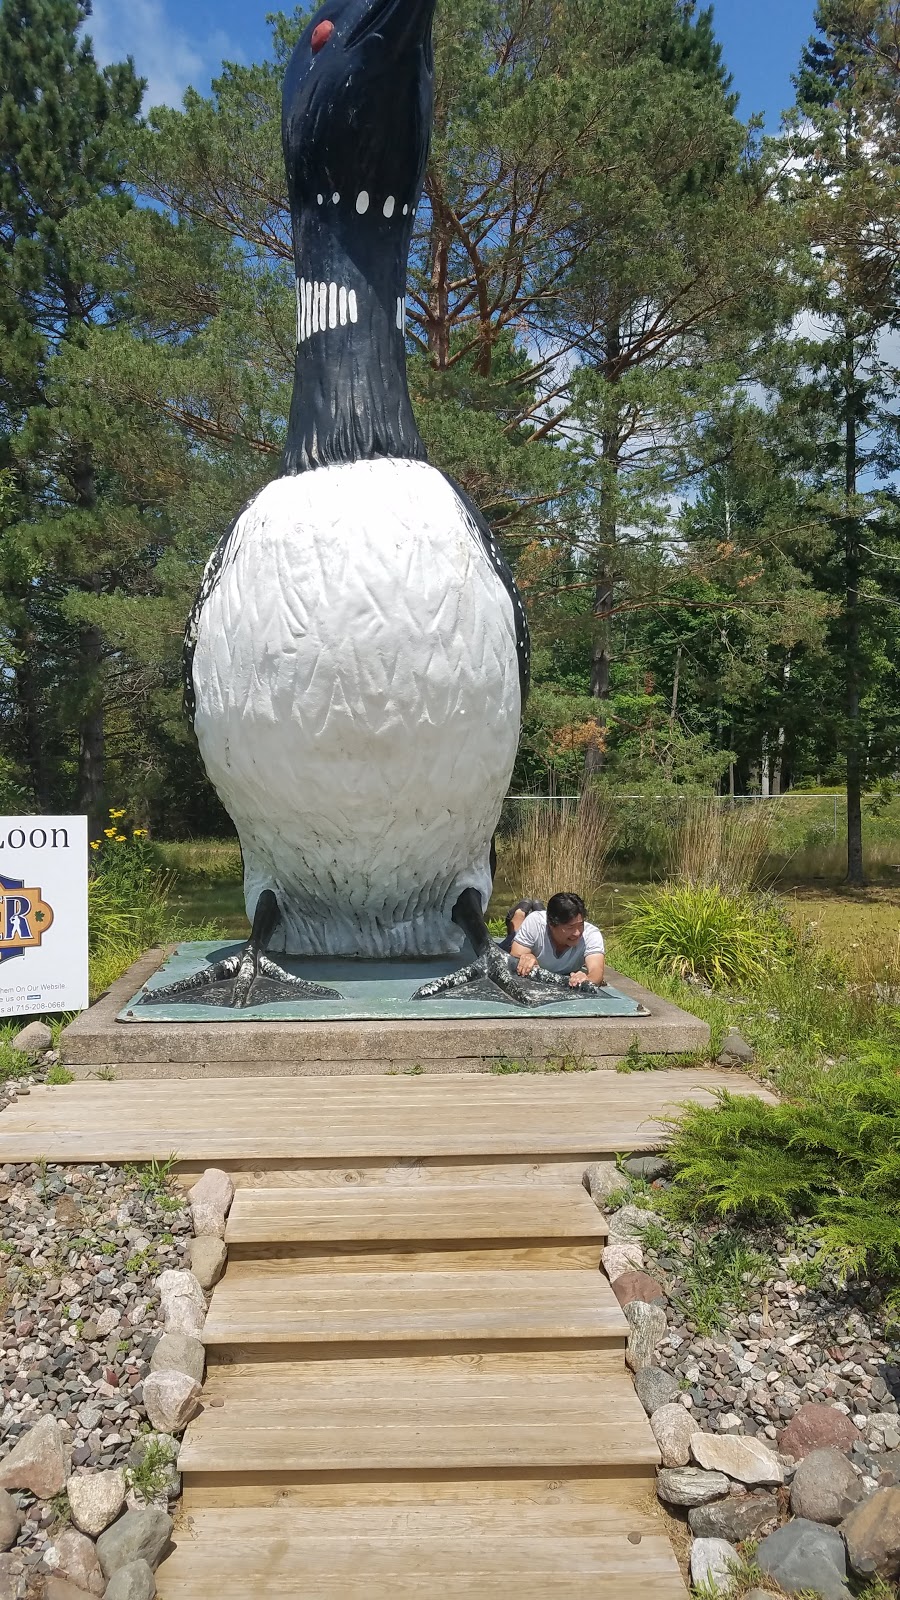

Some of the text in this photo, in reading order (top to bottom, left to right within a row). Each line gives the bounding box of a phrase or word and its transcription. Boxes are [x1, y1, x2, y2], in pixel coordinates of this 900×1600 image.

[0, 828, 70, 849] oon
[16, 985, 26, 993] On
[27, 984, 39, 992] Our
[7, 1005, 14, 1013] at
[16, 1001, 66, 1012] 715-208-0668
